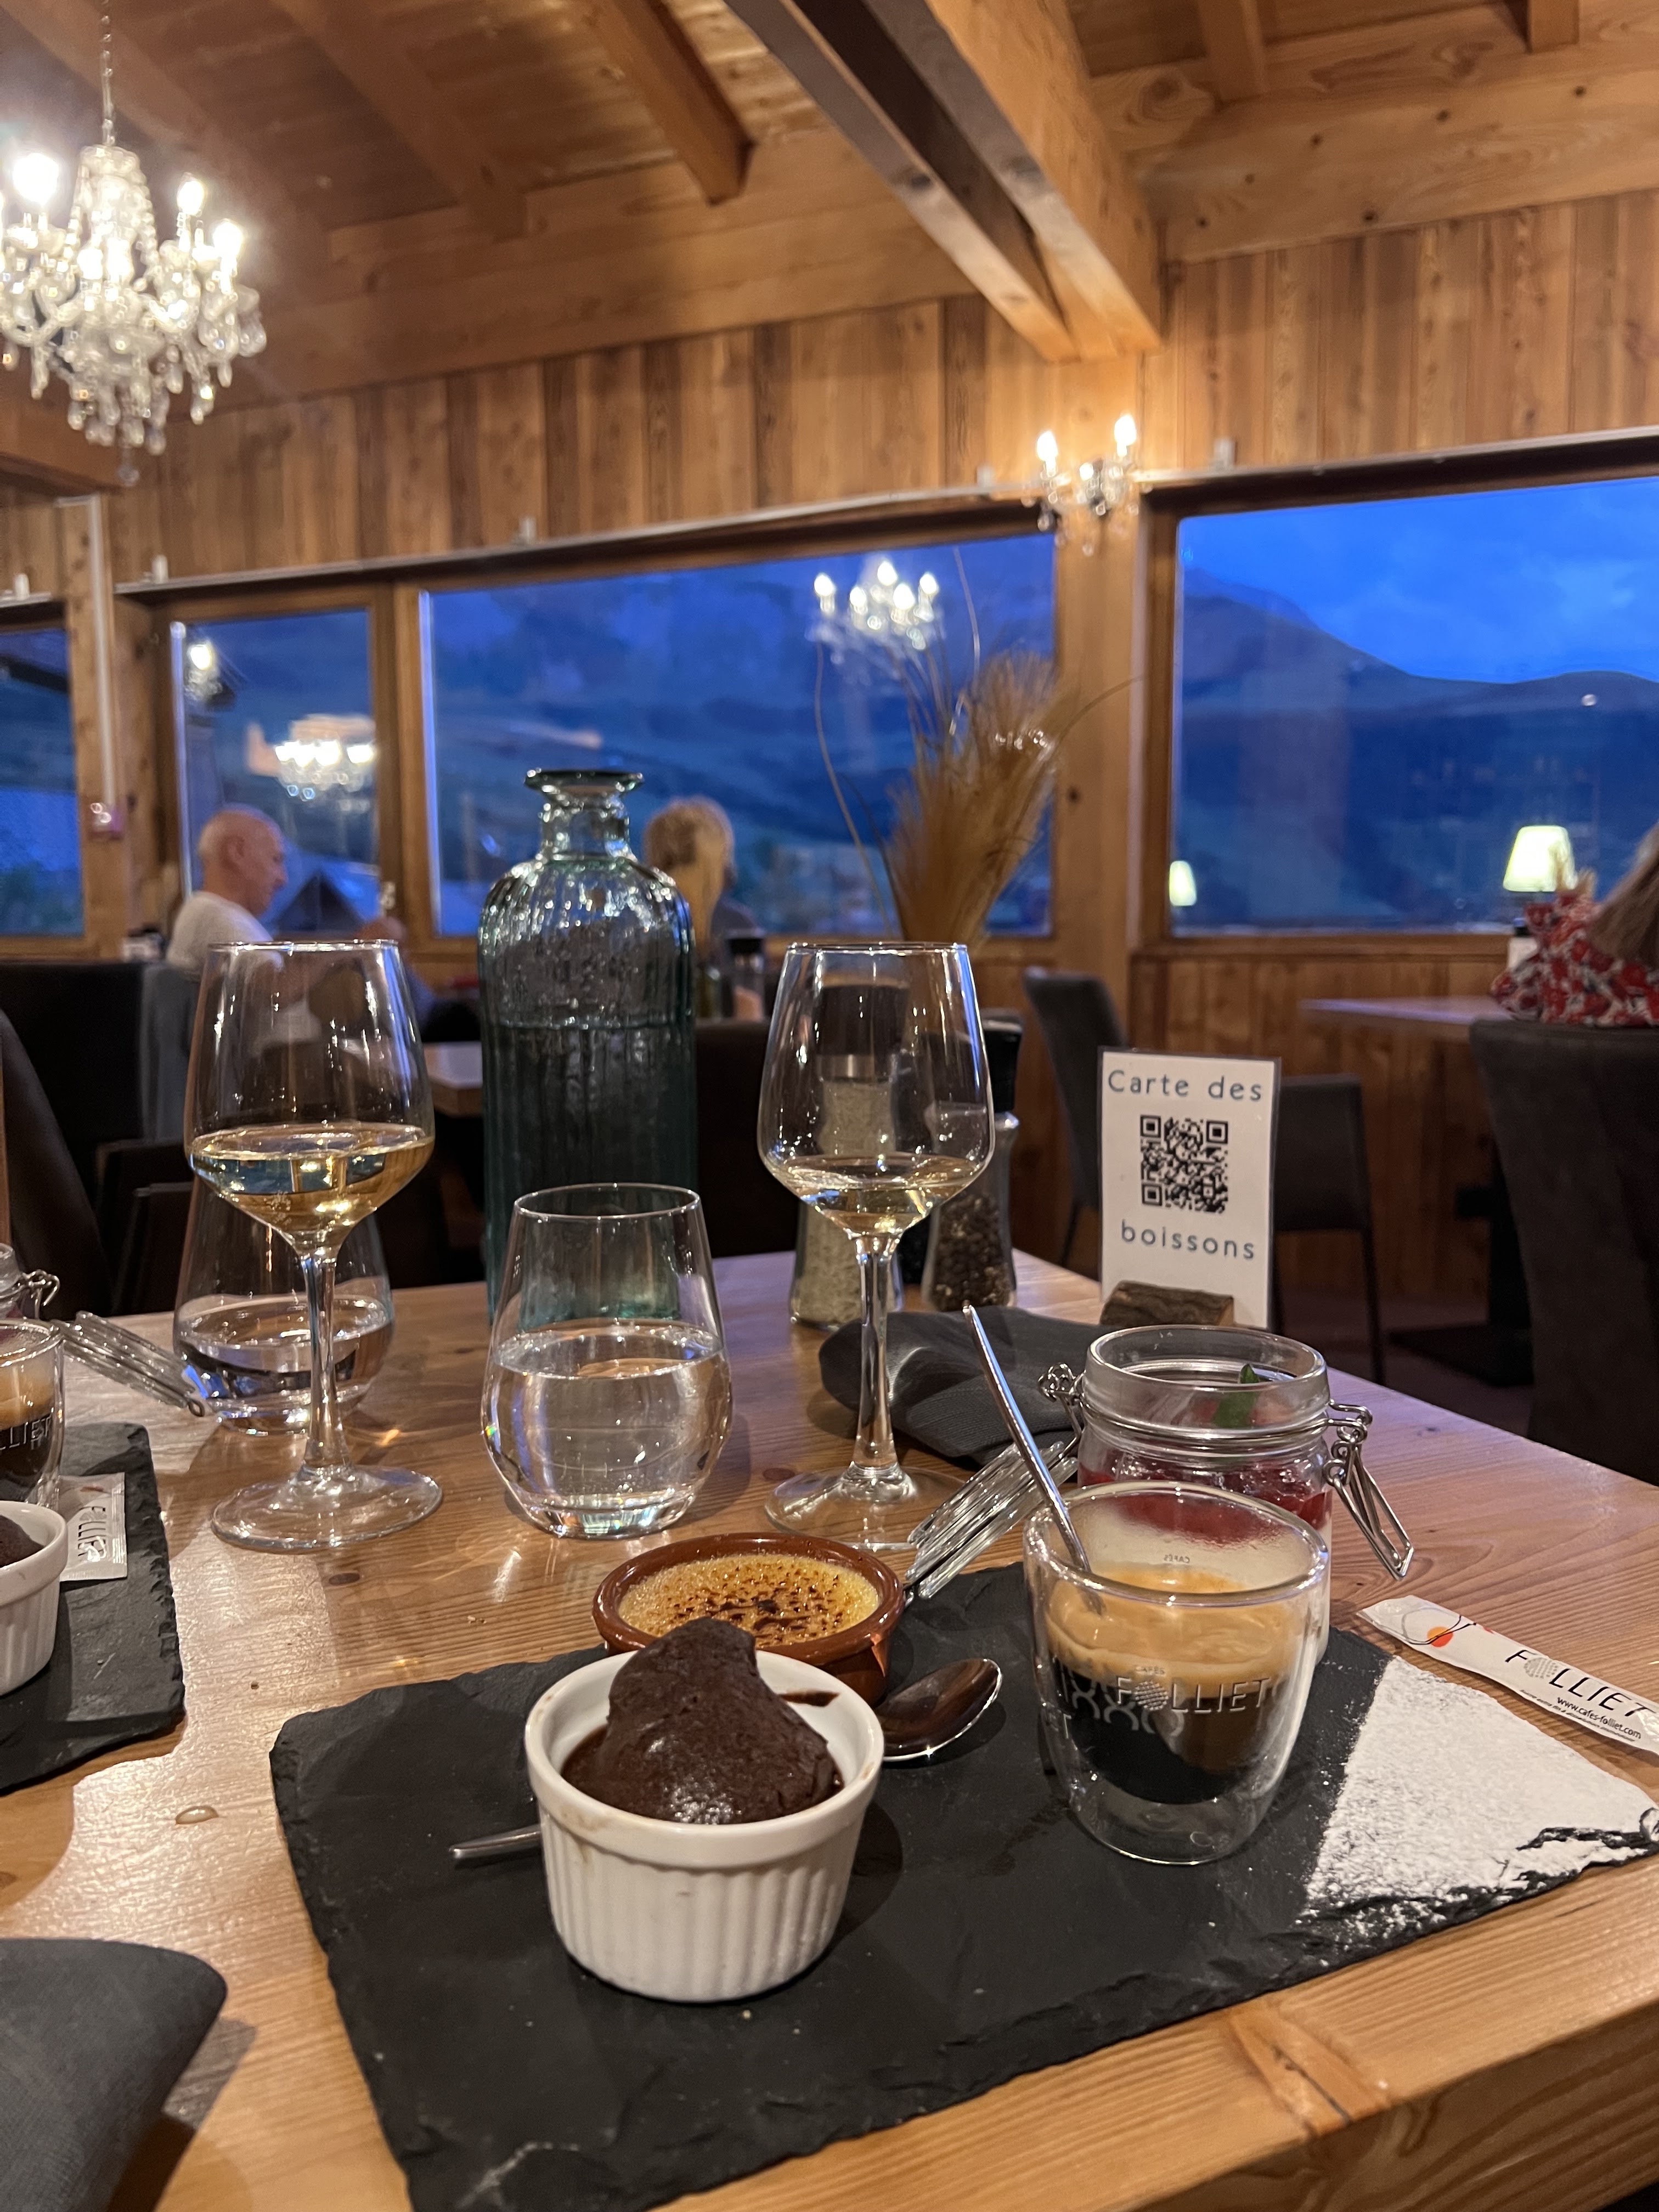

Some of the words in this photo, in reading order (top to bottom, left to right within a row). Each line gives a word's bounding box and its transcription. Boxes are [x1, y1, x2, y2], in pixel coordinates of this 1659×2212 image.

[1108, 1069, 1189, 1097] Carte
[1207, 1075, 1262, 1102] des
[1121, 1218, 1255, 1260] boissons
